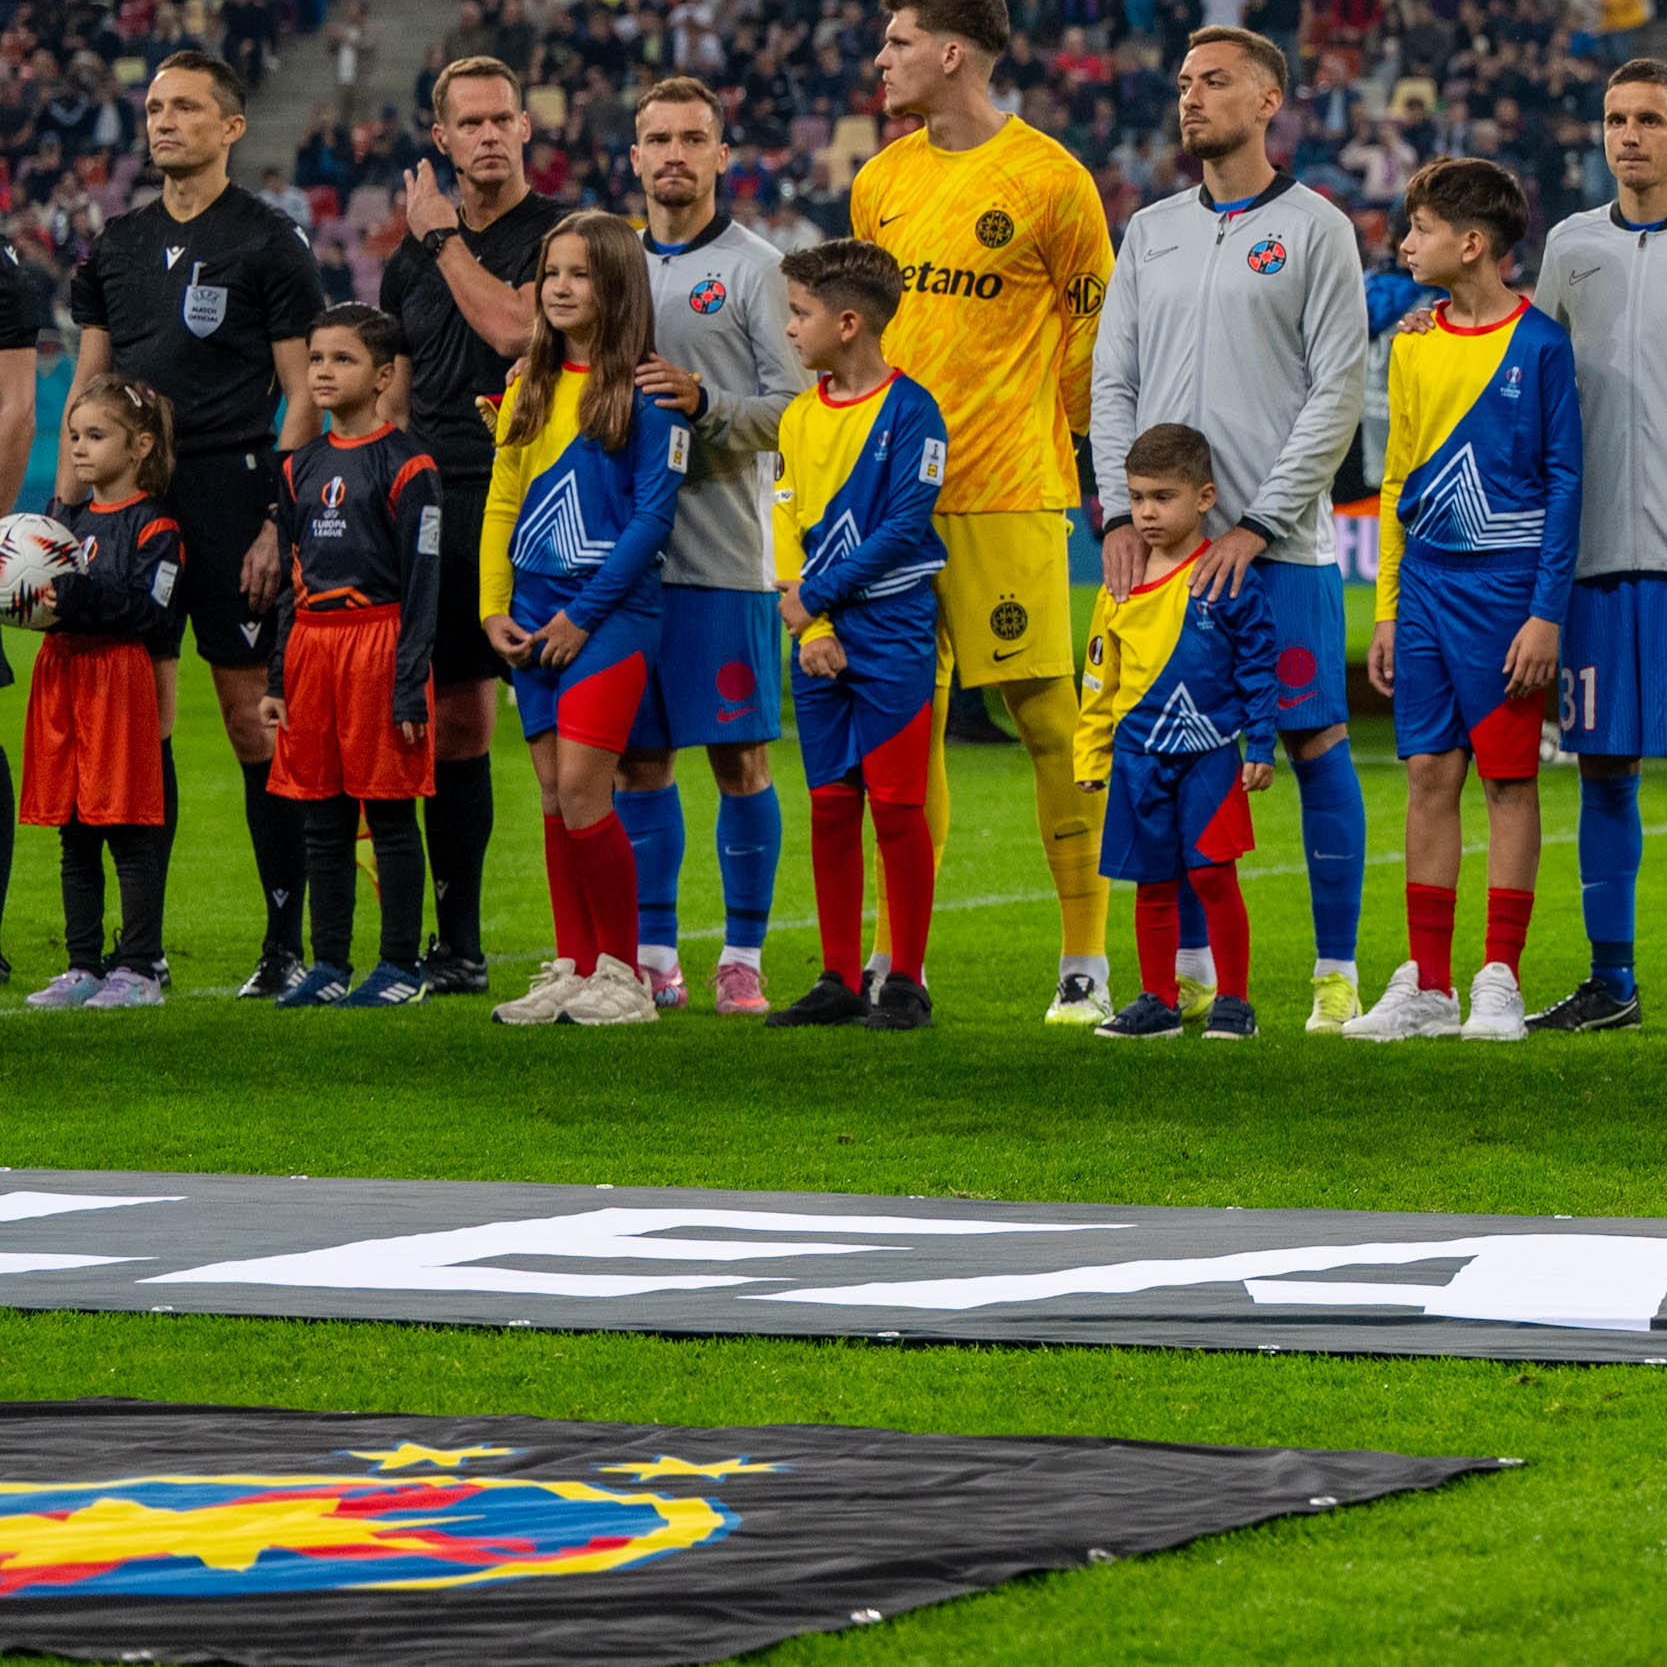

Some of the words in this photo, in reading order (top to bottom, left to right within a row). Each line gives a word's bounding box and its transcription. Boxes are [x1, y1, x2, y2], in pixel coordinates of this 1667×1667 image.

[901, 261, 1003, 300] etano
[1066, 275, 1103, 314] MG
[312, 519, 347, 530] EUROPA
[314, 528, 343, 538] LEAGUE
[1560, 665, 1597, 731] 31
